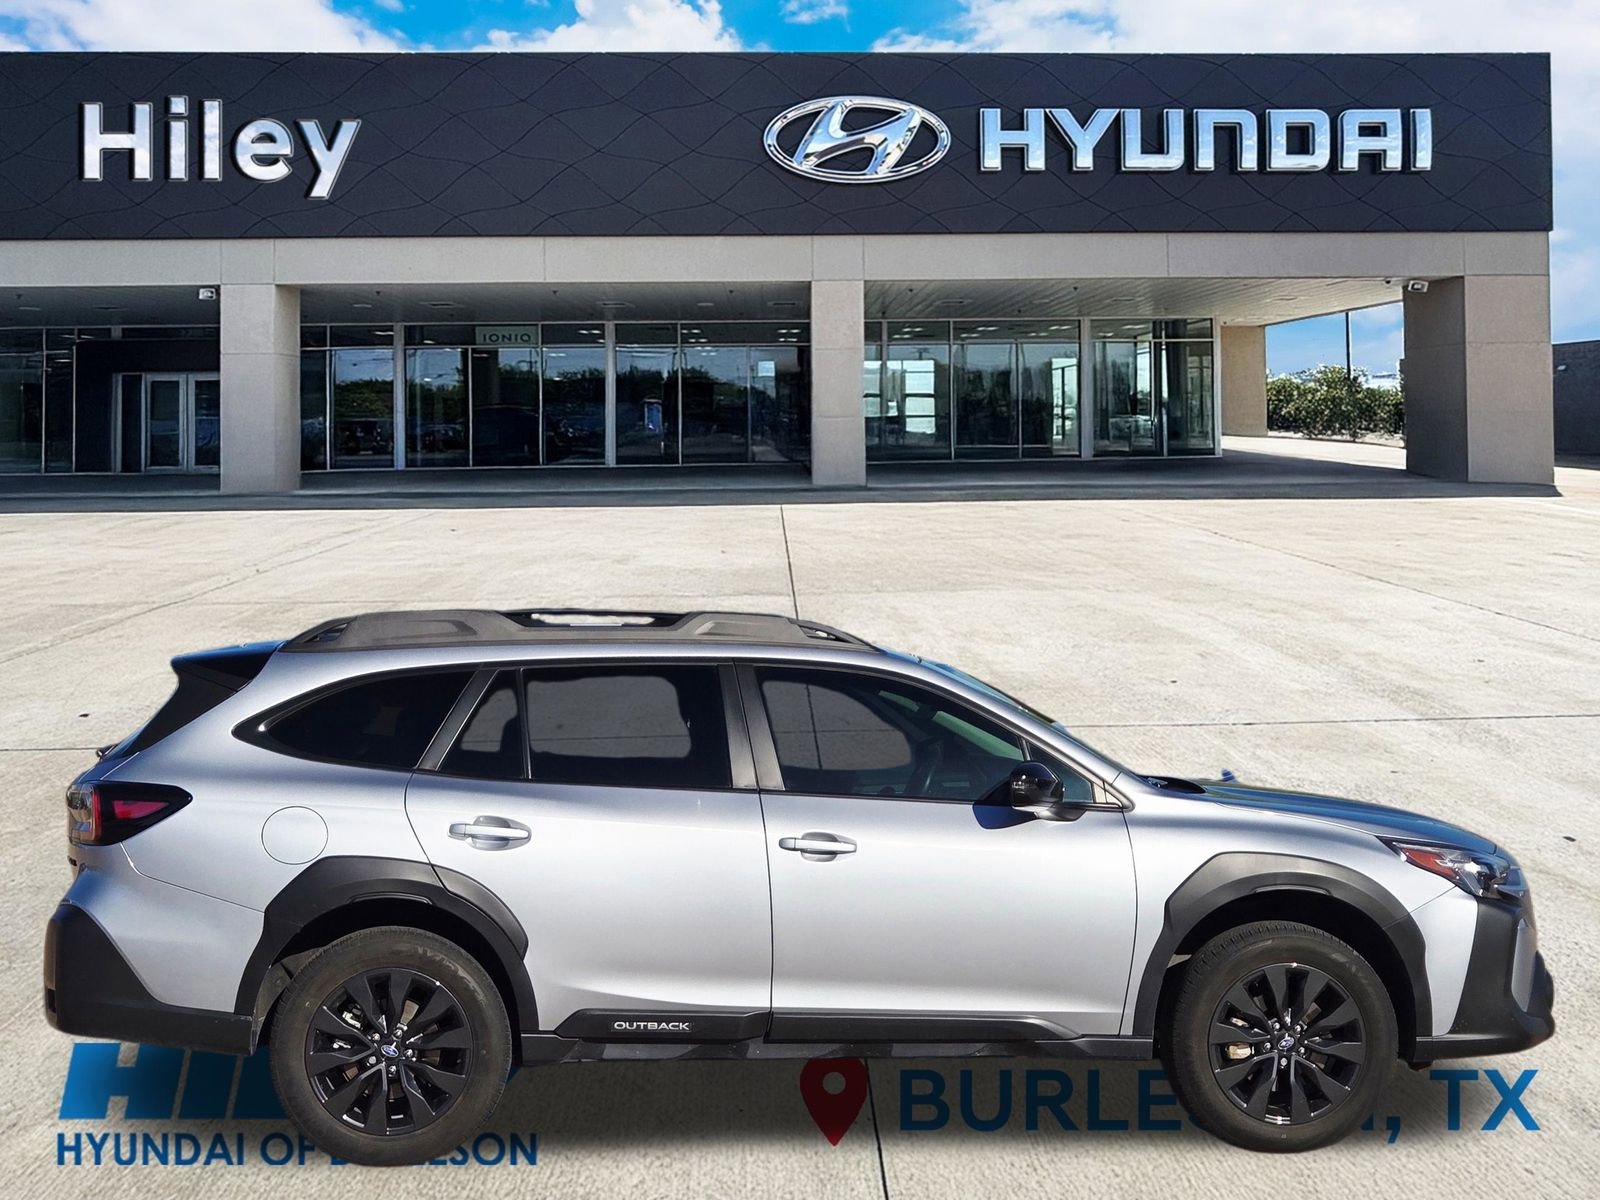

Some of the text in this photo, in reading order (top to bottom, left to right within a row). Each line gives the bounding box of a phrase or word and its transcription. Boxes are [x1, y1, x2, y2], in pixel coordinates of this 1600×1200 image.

[80, 95, 362, 200] Hiley
[979, 107, 1433, 173] HYUNDAI
[613, 1021, 690, 1031] OUTBACK
